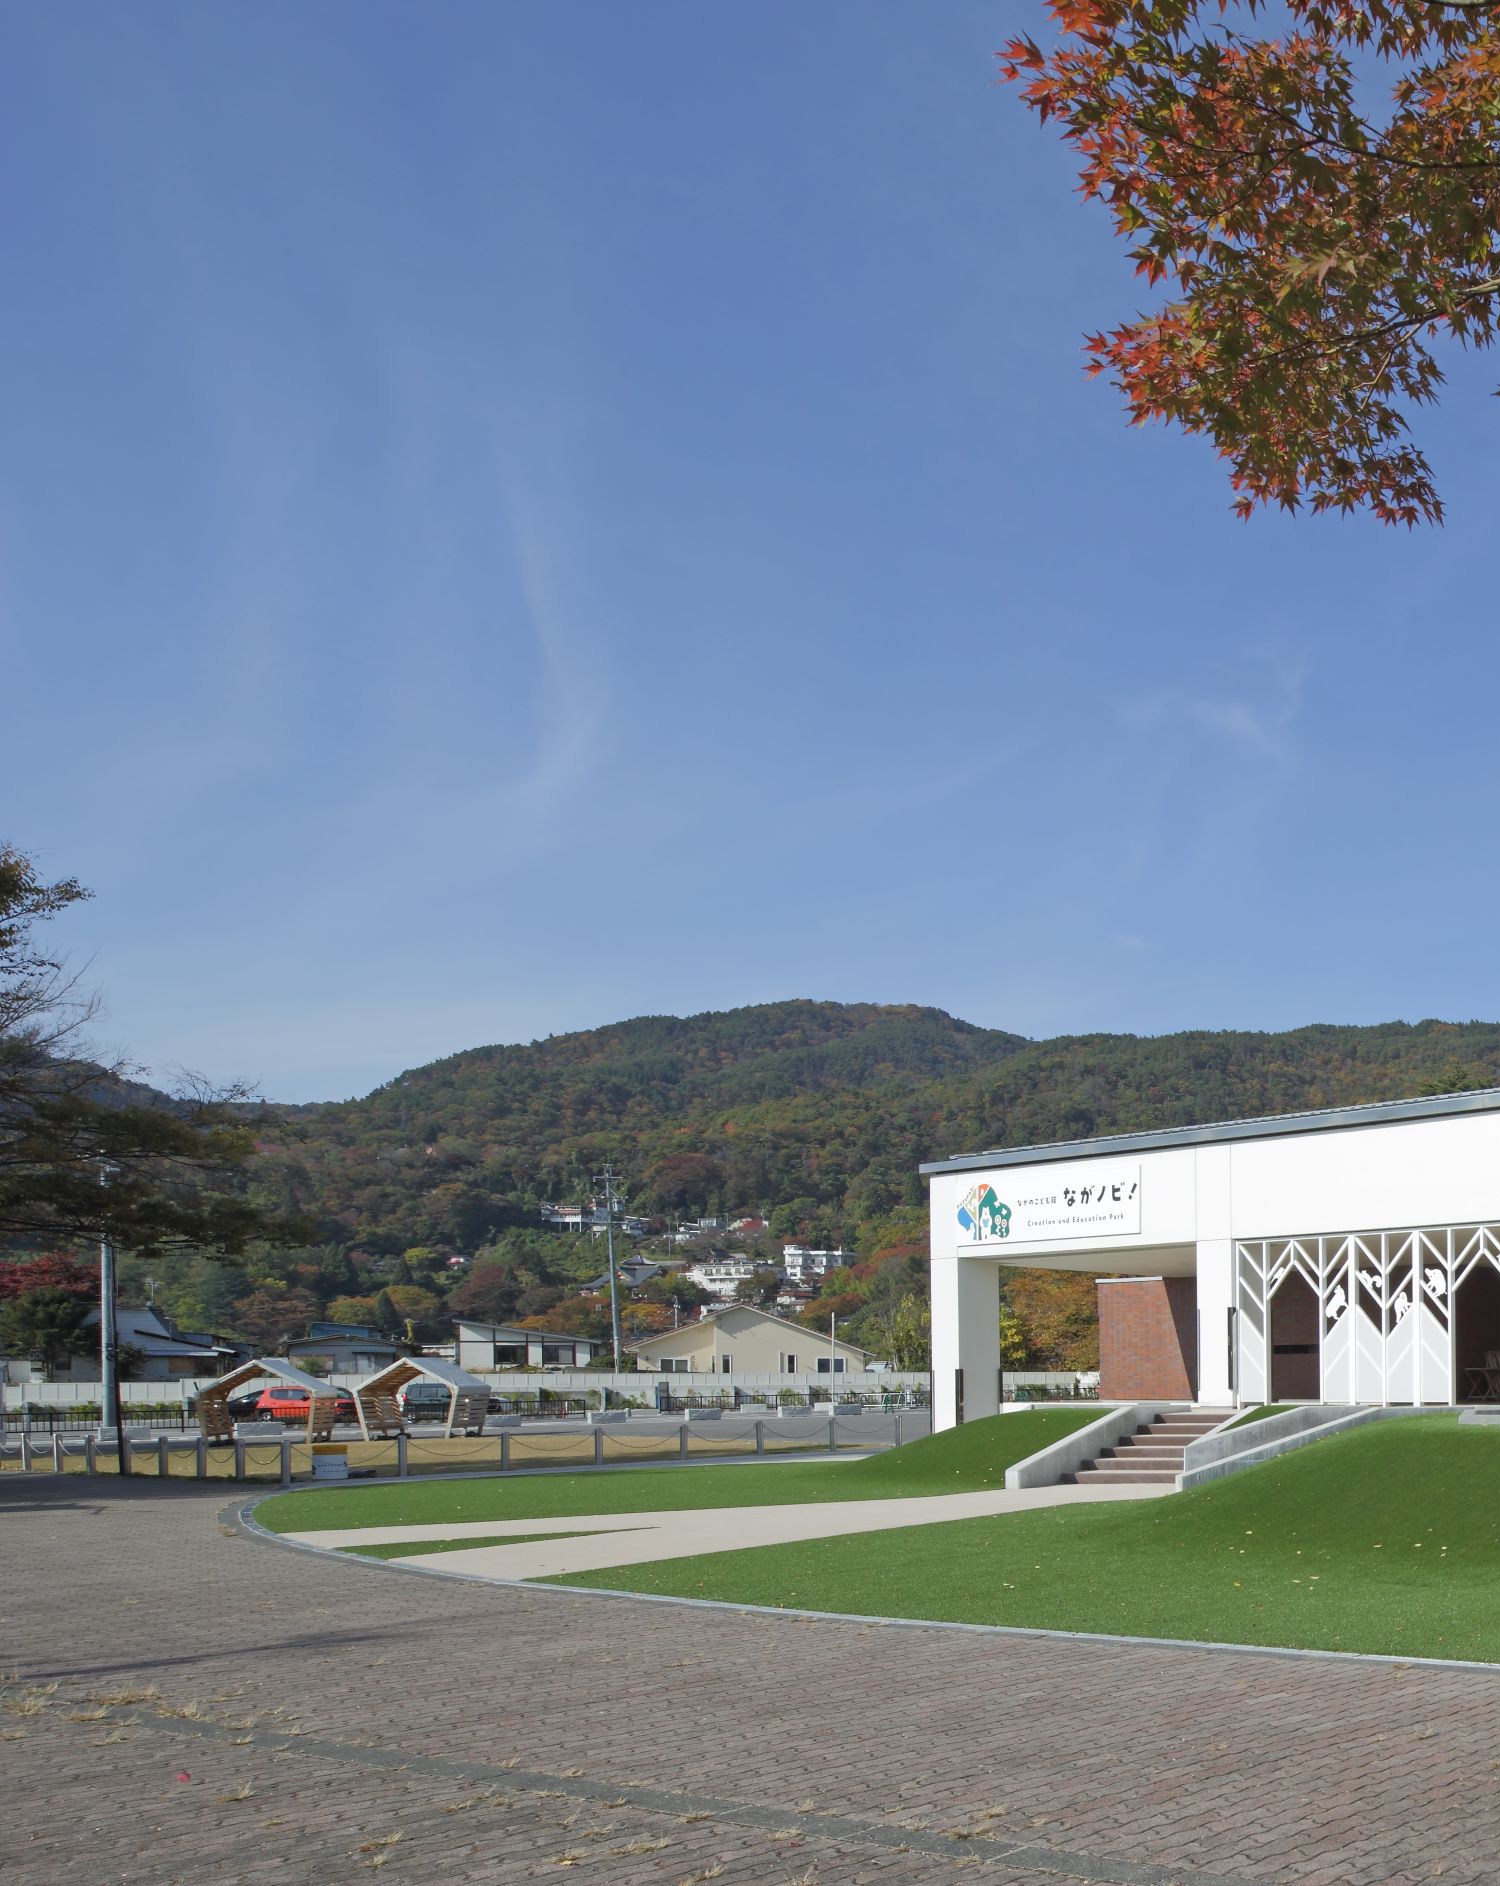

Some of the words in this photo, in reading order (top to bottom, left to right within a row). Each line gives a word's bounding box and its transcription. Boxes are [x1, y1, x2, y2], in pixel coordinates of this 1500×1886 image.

[1027, 1217, 1056, 1227] Creation
[1072, 1214, 1107, 1223] Education
[1109, 1212, 1124, 1220] Park
